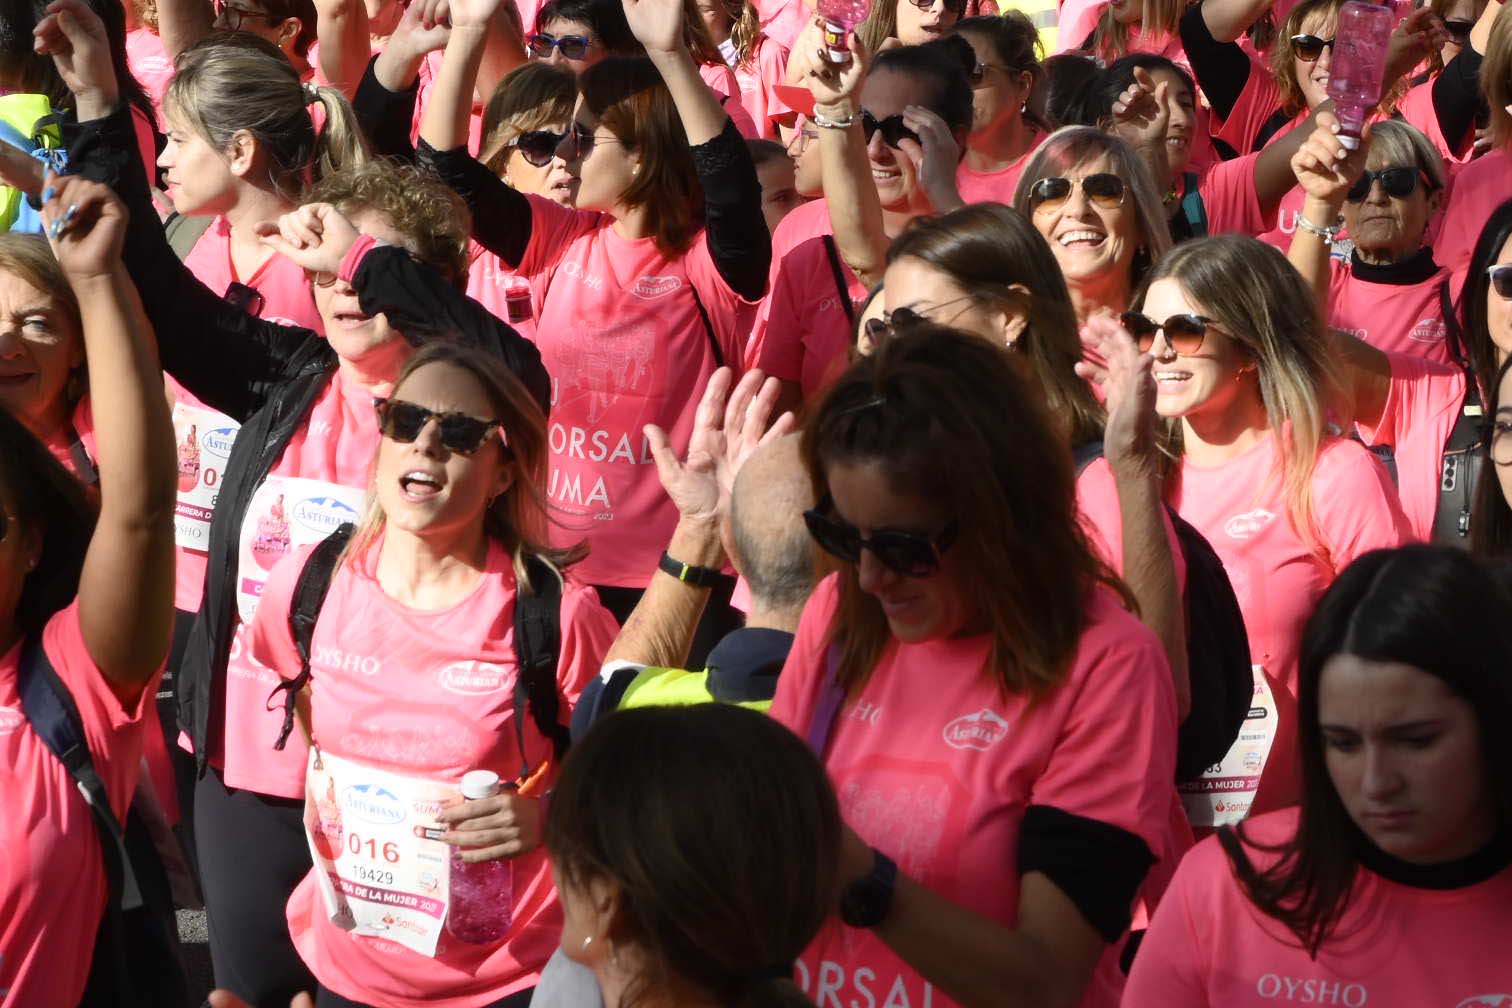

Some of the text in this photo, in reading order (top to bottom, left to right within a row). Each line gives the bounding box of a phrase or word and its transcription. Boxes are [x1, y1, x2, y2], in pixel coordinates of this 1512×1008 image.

[1215, 780, 1245, 790] MUJER
[348, 832, 401, 865] 016
[352, 864, 394, 886] 19429
[355, 886, 368, 899] DE
[368, 890, 383, 902] LA
[383, 892, 418, 907] MUJER
[1255, 972, 1368, 1008] OYSHO
